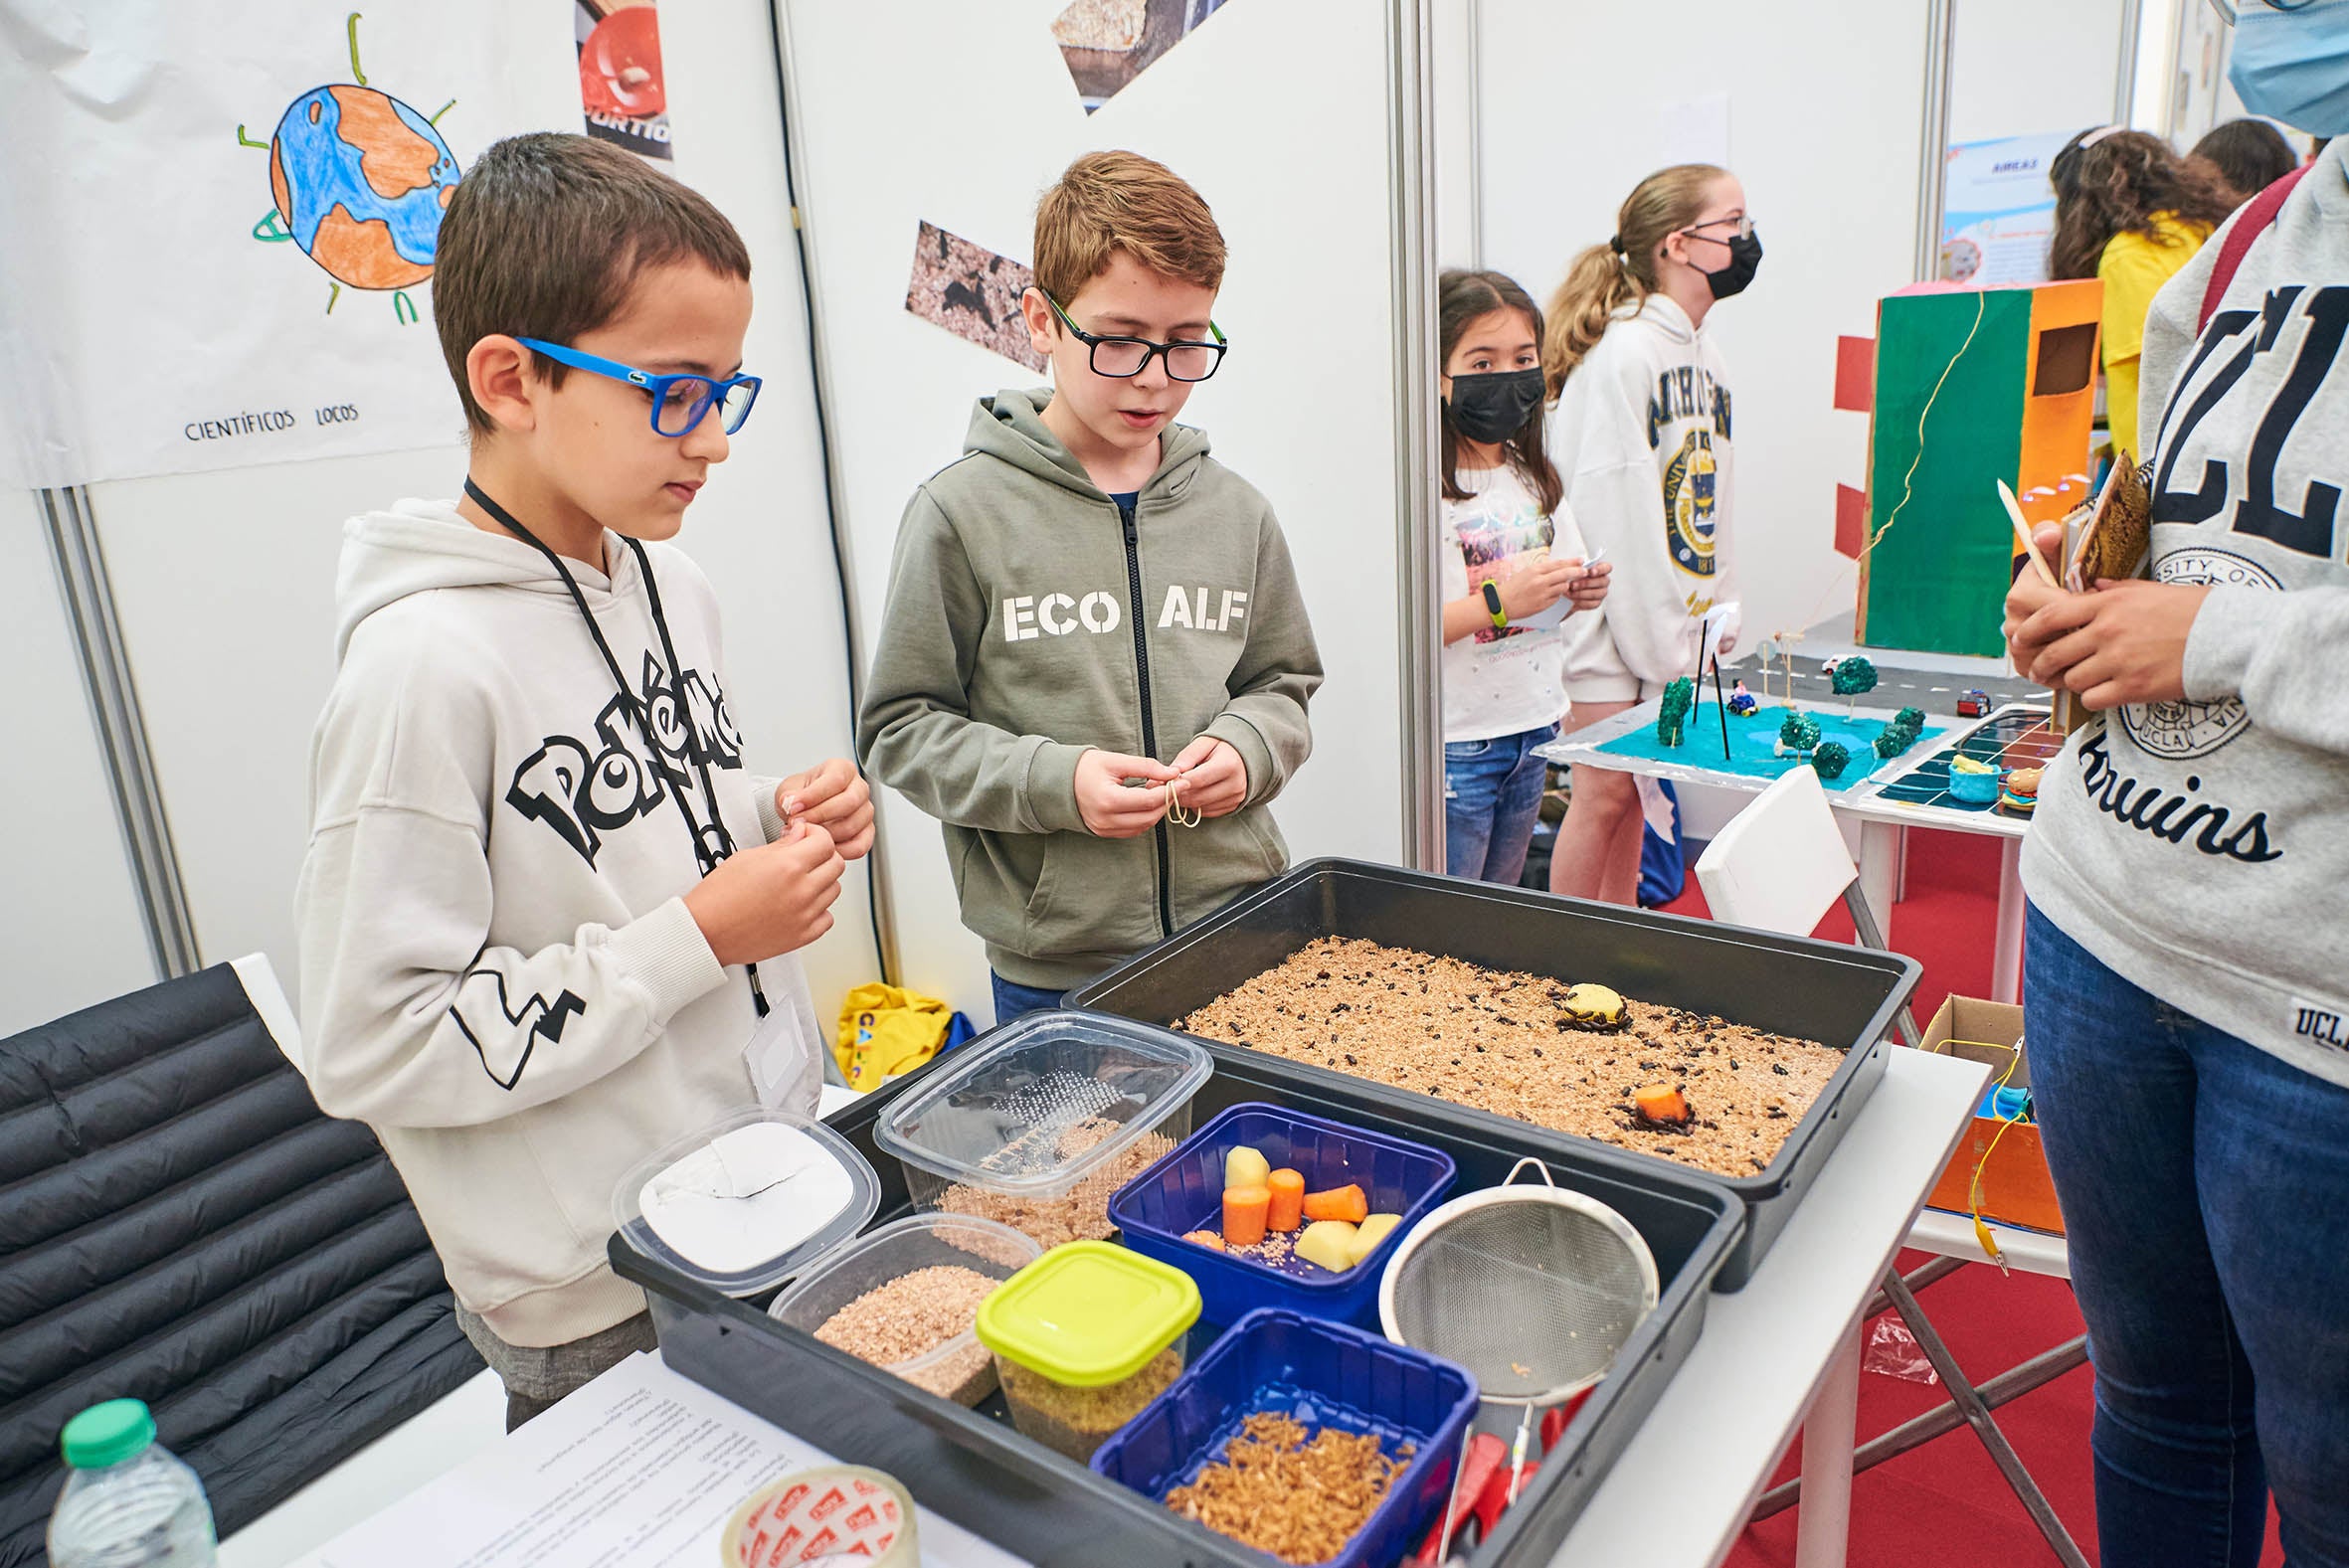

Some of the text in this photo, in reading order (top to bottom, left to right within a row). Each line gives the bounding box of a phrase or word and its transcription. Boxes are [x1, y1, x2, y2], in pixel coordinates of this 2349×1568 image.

[185, 404, 359, 440] CIENTÍFICOS LOCOS
[1002, 592, 1121, 641] ECO
[1157, 585, 1248, 631] ALF
[2142, 723, 2184, 748] UCLA
[2295, 1007, 2349, 1052] UCL
